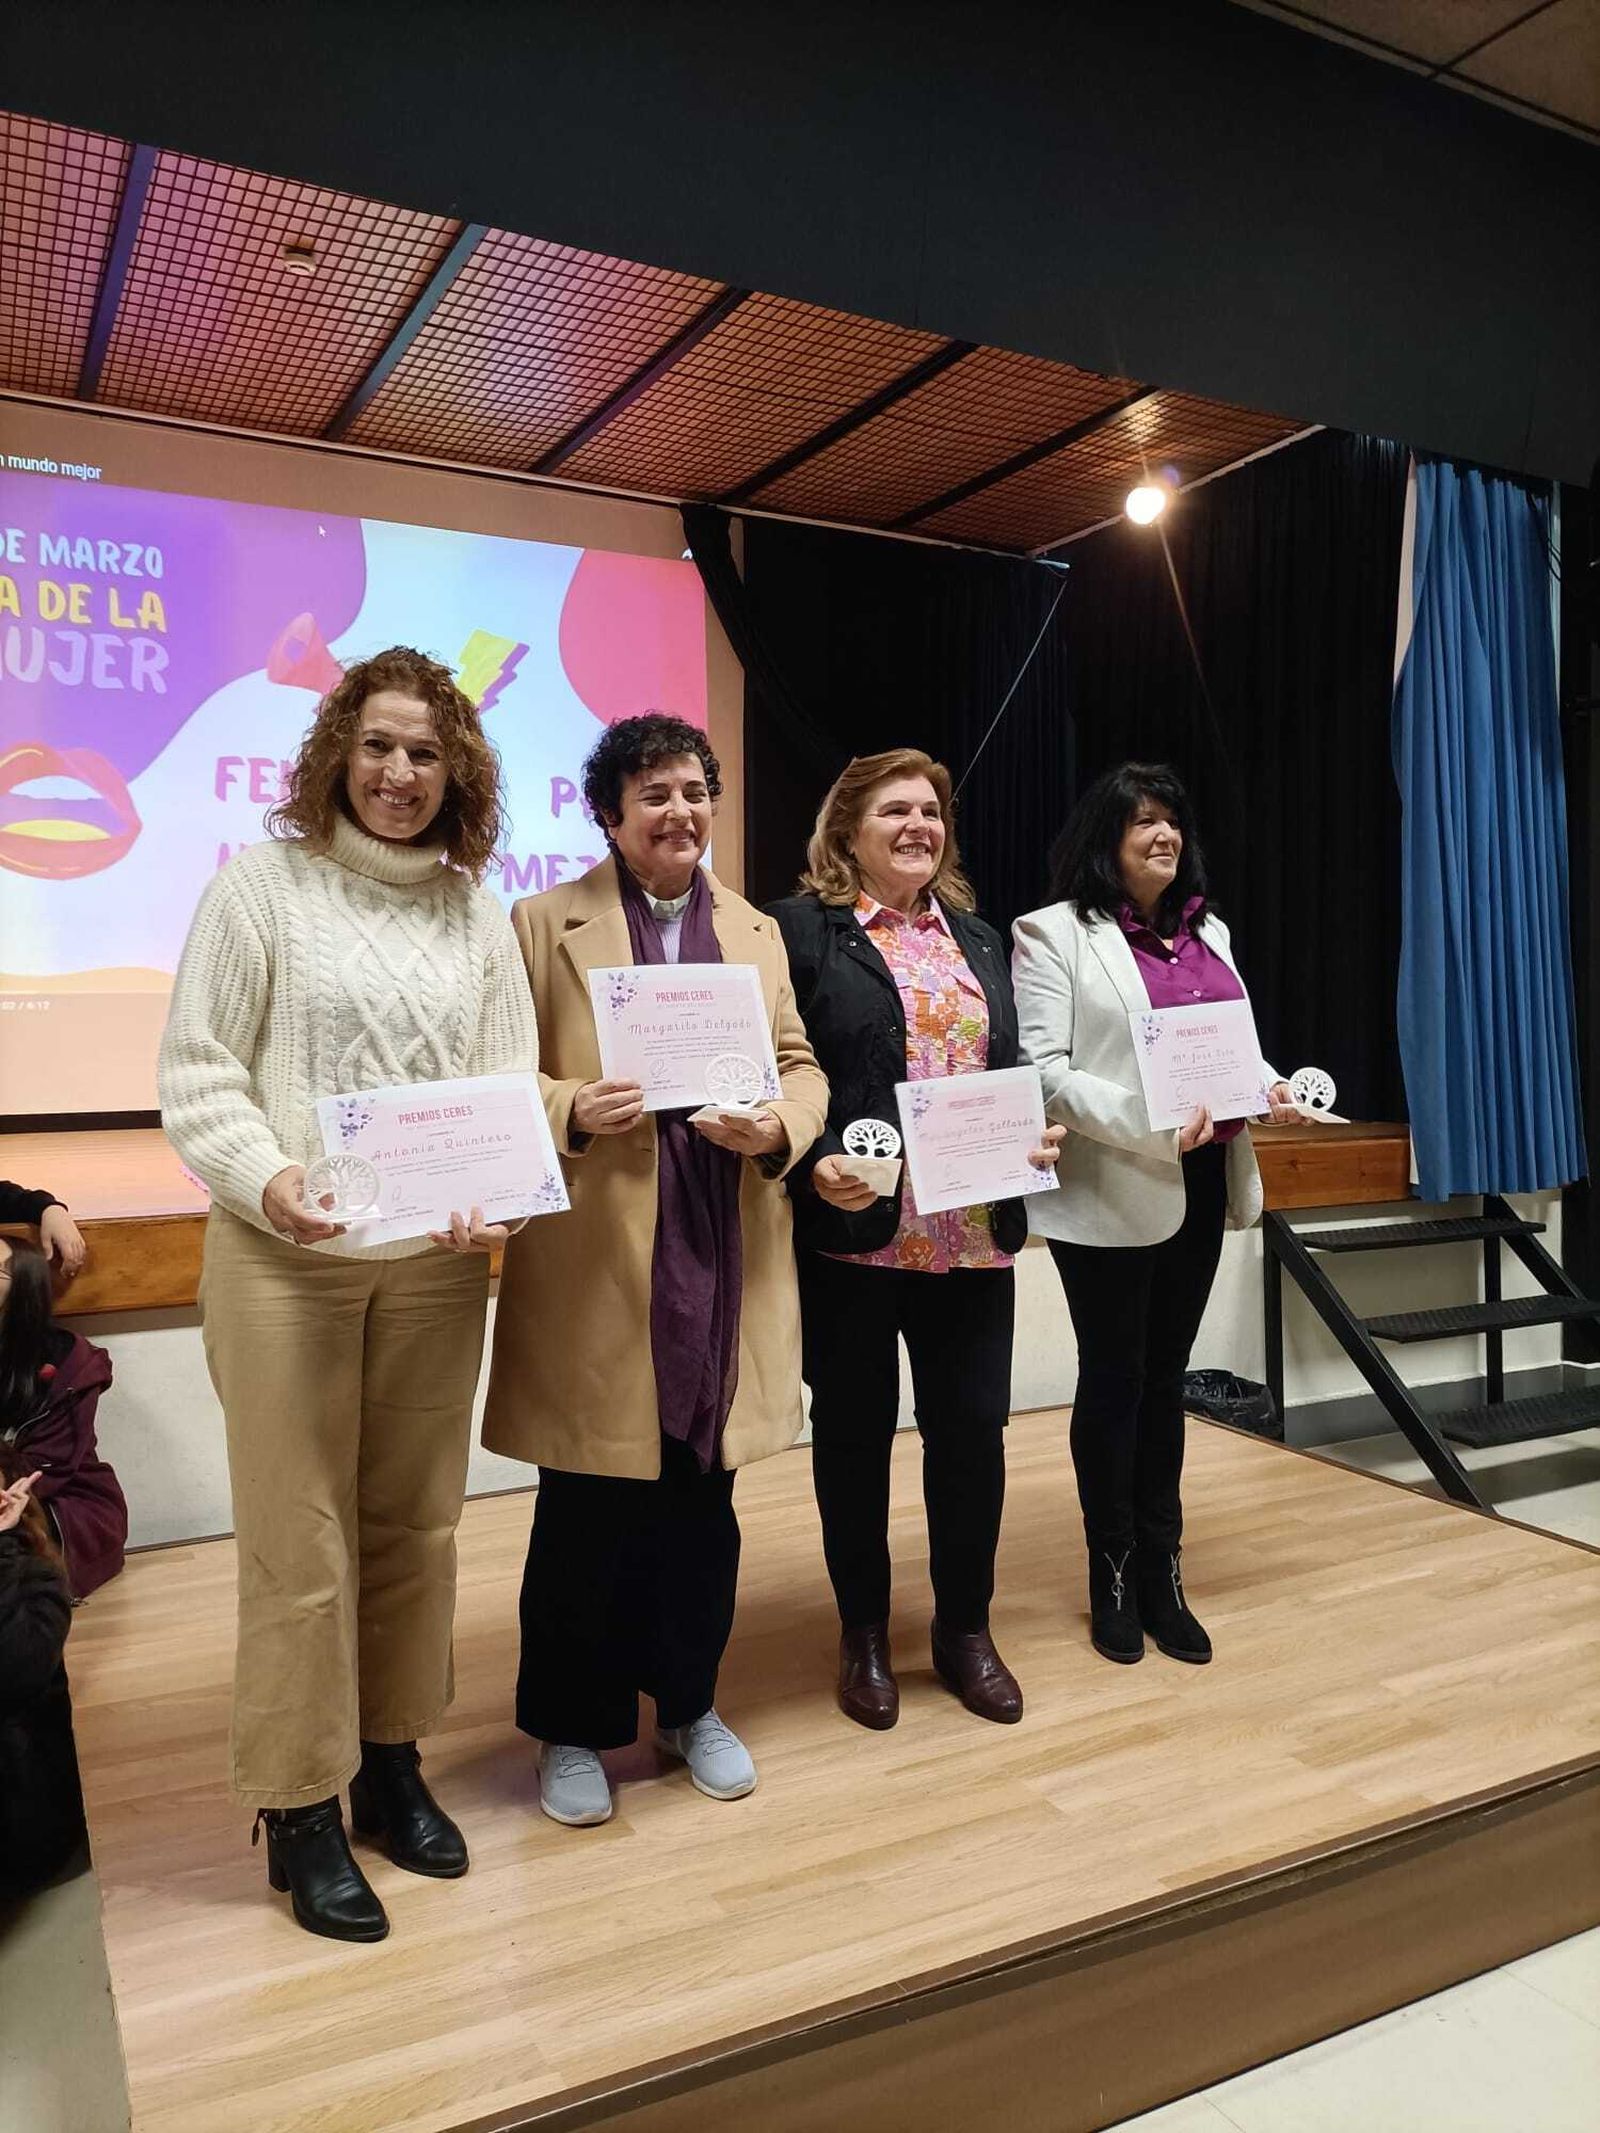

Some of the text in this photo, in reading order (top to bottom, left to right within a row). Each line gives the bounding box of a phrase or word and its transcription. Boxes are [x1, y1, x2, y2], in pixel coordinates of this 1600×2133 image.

[7, 455, 57, 473] mundo
[61, 462, 102, 480] mejor
[39, 532, 163, 579] MARZO
[39, 580, 93, 624] DE
[109, 587, 167, 633] LA
[0, 626, 170, 694] UJER
[655, 990, 714, 1003] PREMIOS CERES
[628, 1020, 697, 1036] Margarita
[398, 1107, 442, 1125] PREMIOS
[443, 1105, 474, 1119] CERES
[370, 1133, 512, 1162] Antonia Quintero
